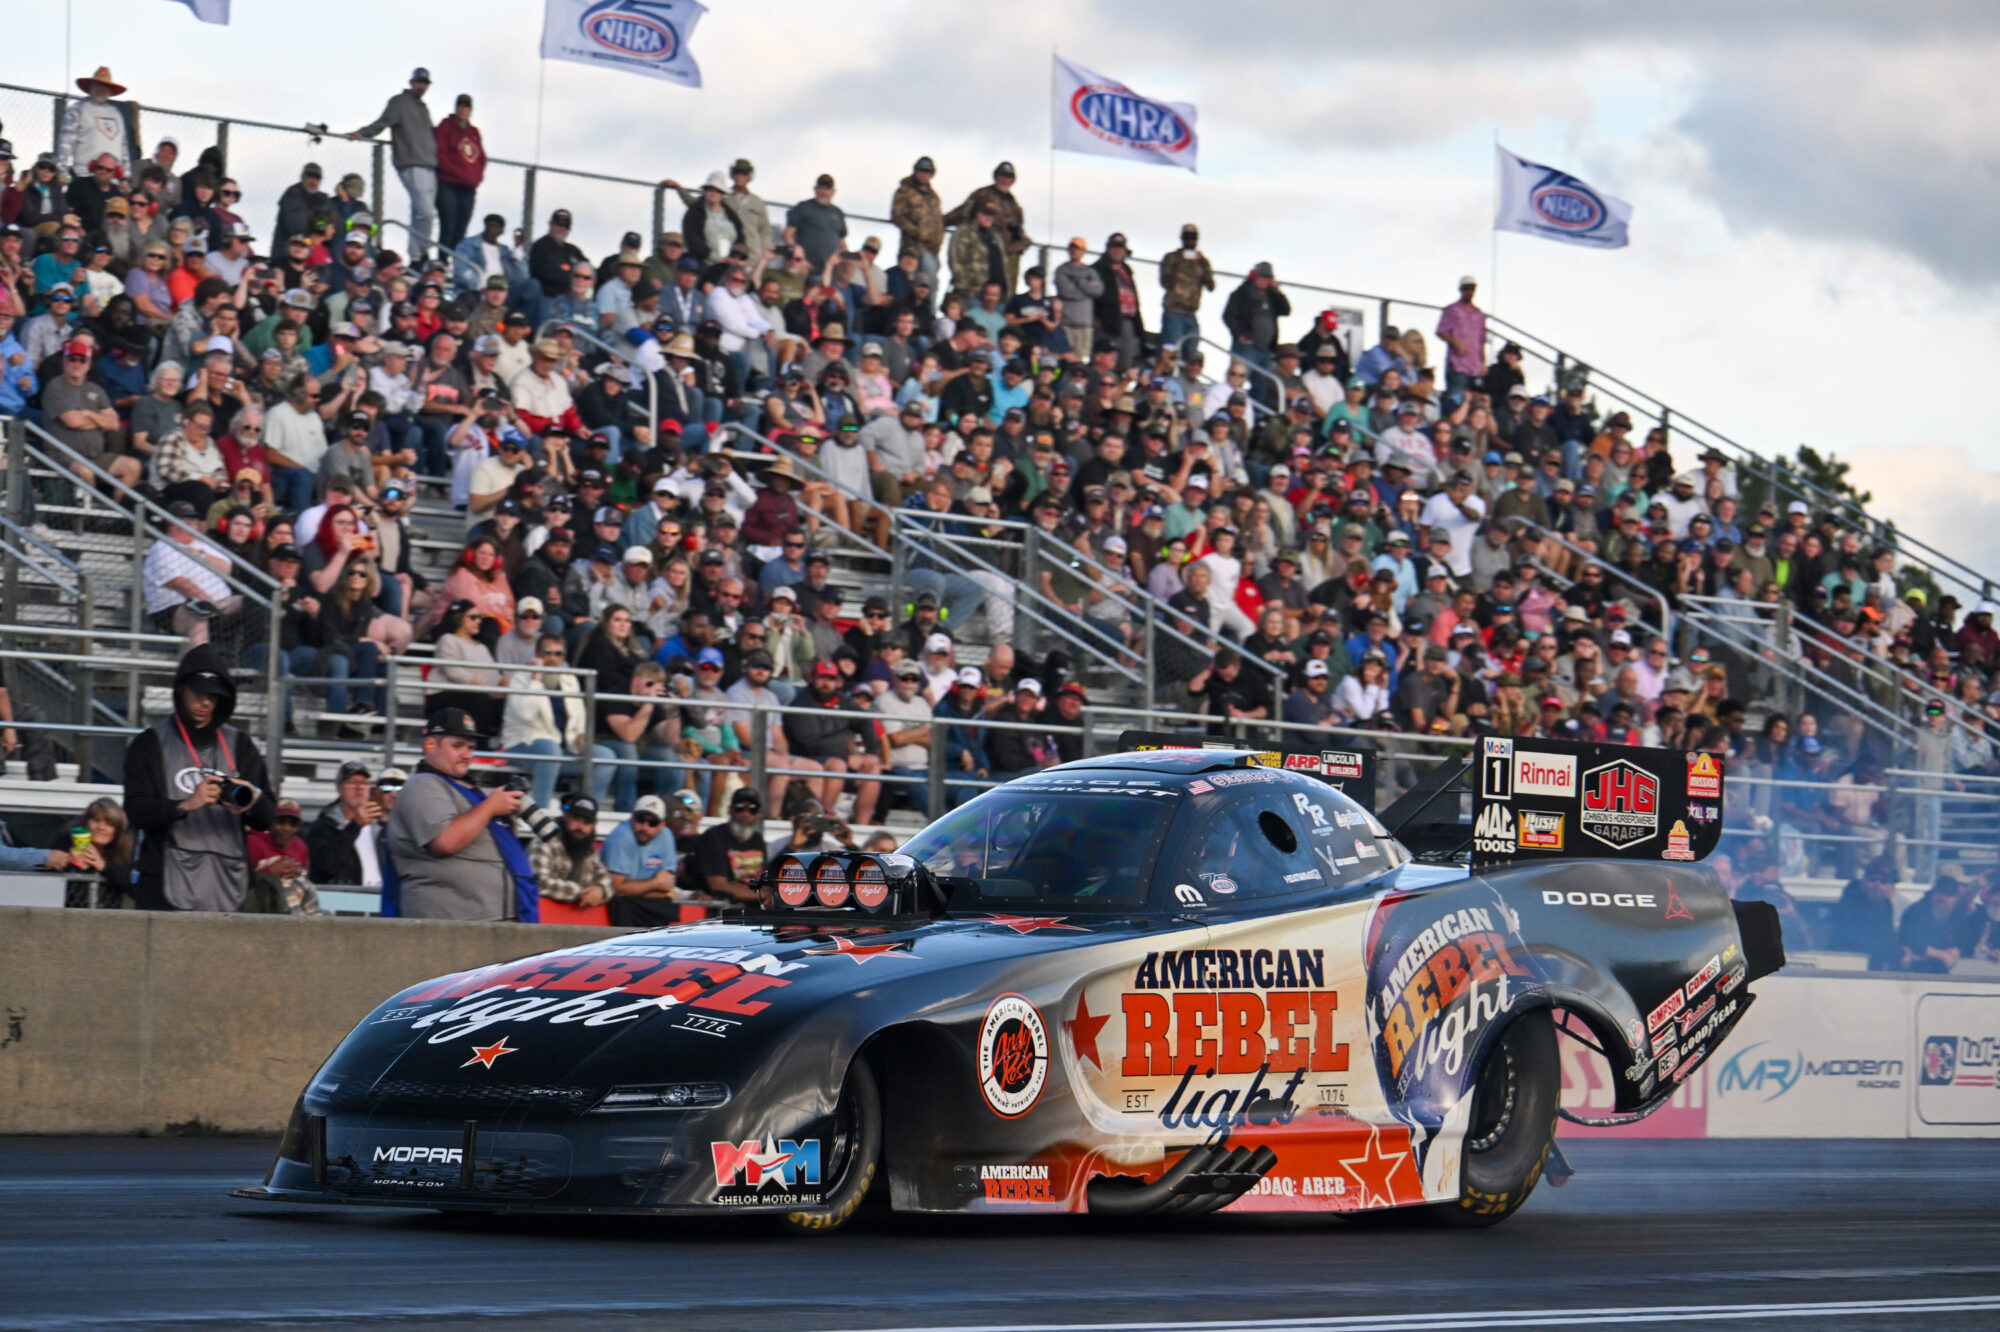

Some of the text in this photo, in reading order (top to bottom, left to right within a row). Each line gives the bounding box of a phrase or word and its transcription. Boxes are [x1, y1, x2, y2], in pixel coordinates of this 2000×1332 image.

[599, 18, 662, 52] NHRA
[1088, 94, 1175, 144] NHRA
[1541, 194, 1590, 223] NHRA
[1322, 752, 1356, 765] LINCOLN
[1486, 741, 1511, 755] Mobil
[1285, 755, 1320, 769] ARP
[1329, 765, 1359, 776] WELDERS
[1492, 759, 1501, 793] 1
[1520, 762, 1571, 787] Rinnai
[1585, 767, 1656, 814] JHG
[1474, 803, 1516, 839] MAC
[1583, 811, 1613, 823] JOHNSON'S
[1593, 825, 1645, 841] GARAGE
[1474, 839, 1516, 854] TOOLS
[1541, 890, 1658, 908] DODGE
[1134, 949, 1325, 990] AMERICAN
[1381, 907, 1494, 1020] AMERICAN
[1687, 965, 1714, 995] COMP
[381, 1008, 421, 1020] EST
[410, 984, 683, 1044] light
[1383, 932, 1535, 1080] REBEL
[1649, 991, 1683, 1030] SIMPSON
[683, 1017, 730, 1032] 1776
[987, 1003, 1023, 1037] AMERICAN
[1027, 1012, 1044, 1049] REBEL
[1121, 991, 1350, 1077] REBEL
[1413, 973, 1517, 1082] light
[1681, 999, 1737, 1056] GOODYEAR
[1725, 1059, 1792, 1092] MR
[1857, 1080, 1900, 1089] RACING
[1011, 1087, 1036, 1108] PATRIOTIC
[1126, 1094, 1150, 1109] EST
[1157, 1062, 1307, 1148] light
[1320, 1088, 1345, 1102] 1776
[373, 1146, 464, 1164] MOPAR
[373, 1179, 445, 1188] MOPAR.COM
[981, 1165, 1049, 1180] AMERICAN
[984, 1179, 1056, 1203] REBEL
[1246, 1176, 1346, 1197] SDAQ: AREB
[718, 1193, 821, 1205] SHELOR MOTOR MILE
